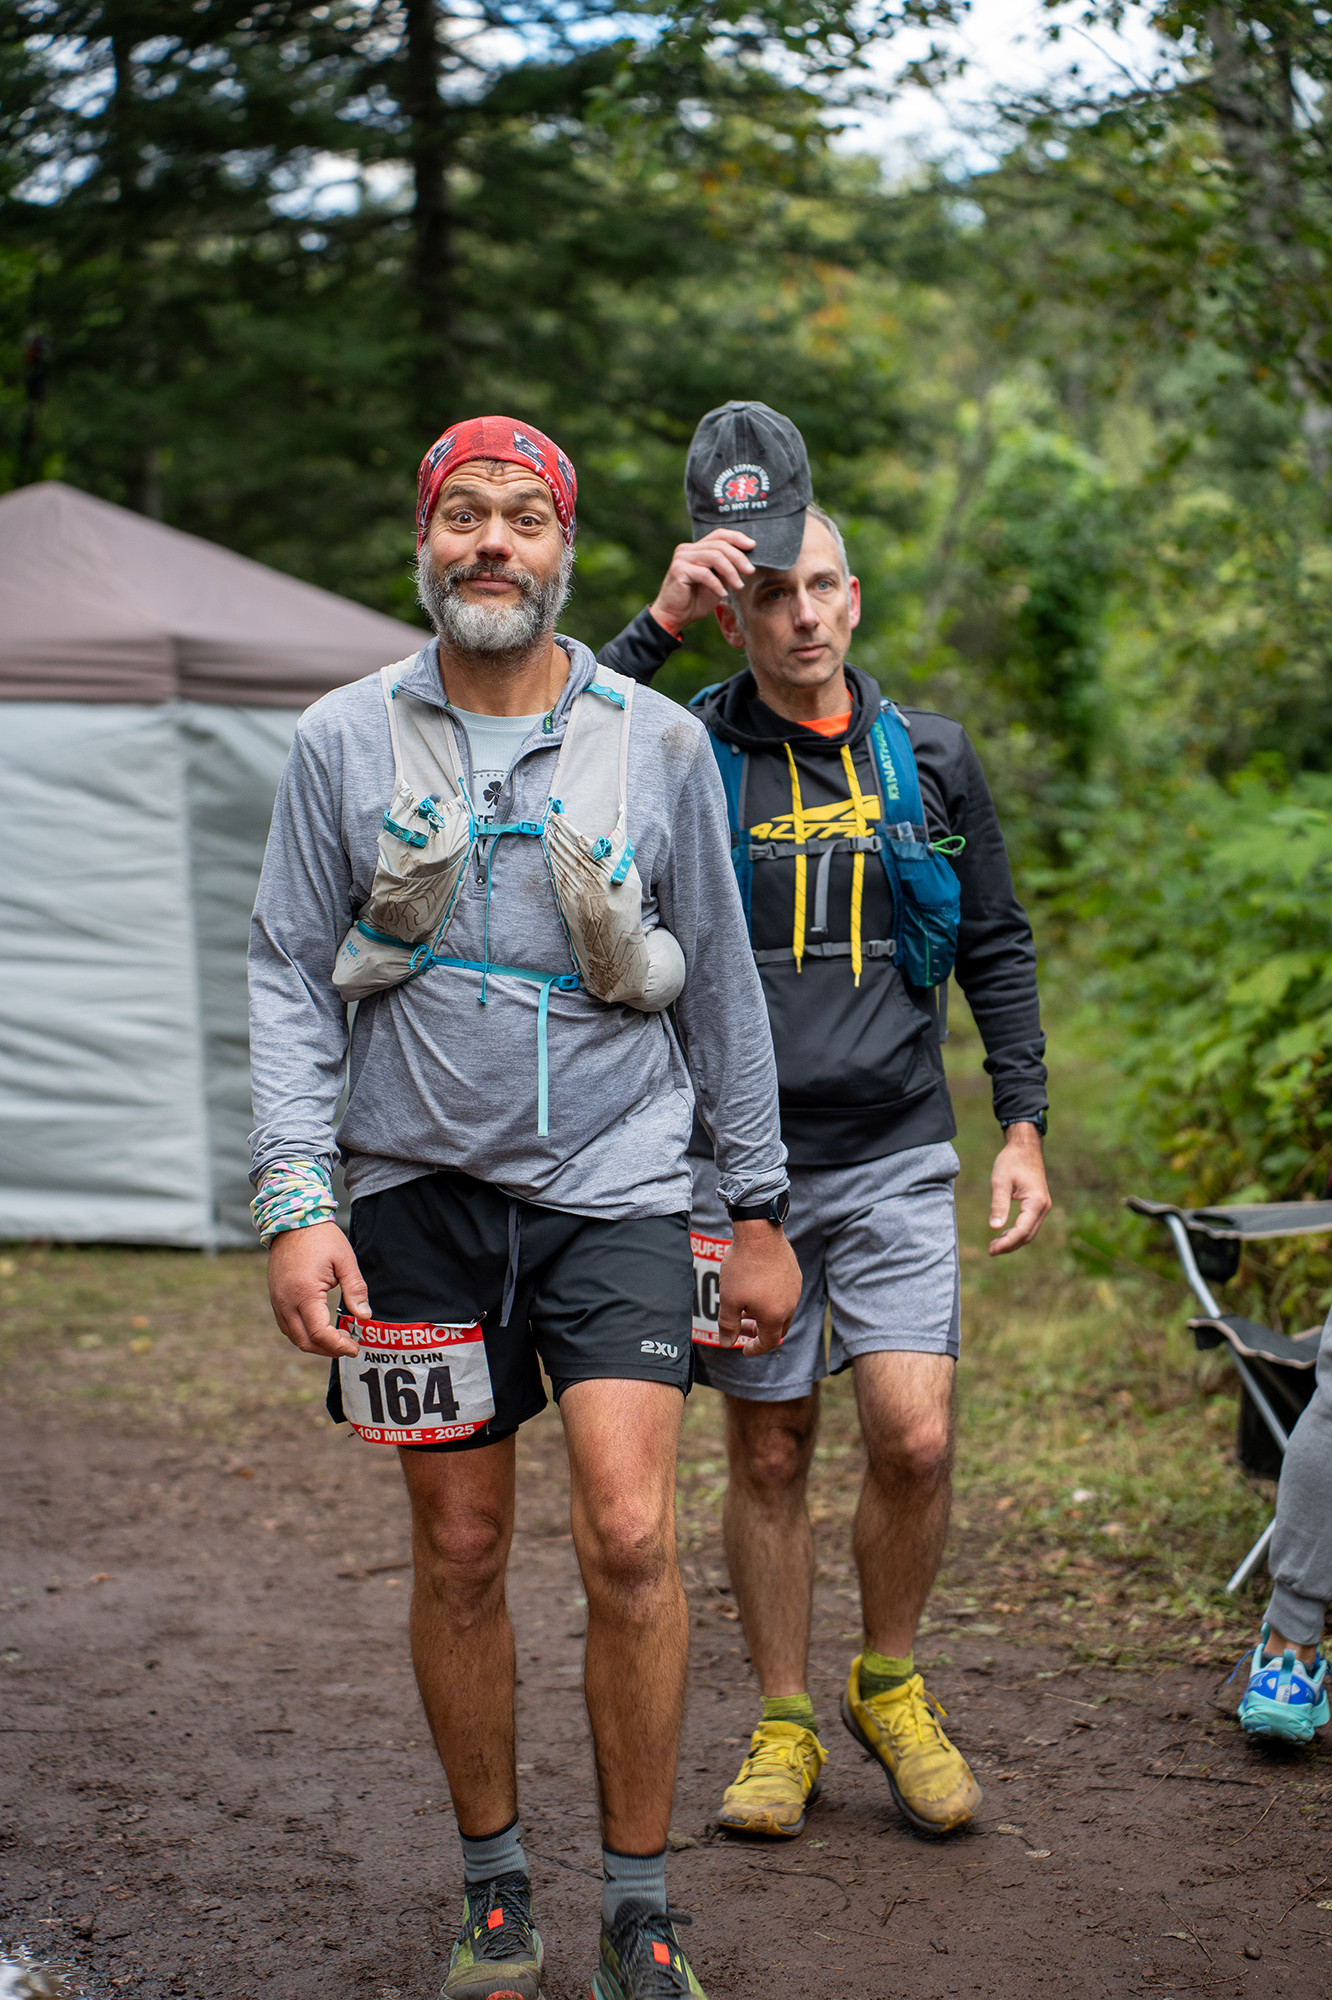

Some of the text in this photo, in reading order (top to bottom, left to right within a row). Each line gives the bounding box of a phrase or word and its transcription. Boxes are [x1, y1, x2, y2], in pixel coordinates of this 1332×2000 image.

[718, 500, 768, 513] DO NOT PET
[873, 721, 897, 784] NATHAN
[365, 1326, 465, 1346] SUPERIOR
[364, 1351, 444, 1365] ANDY LOHN
[640, 1340, 678, 1358] 2XU
[359, 1366, 460, 1426] 164
[358, 1427, 381, 1441] 100
[385, 1430, 423, 1442] MILE
[434, 1425, 475, 1440] 2025
